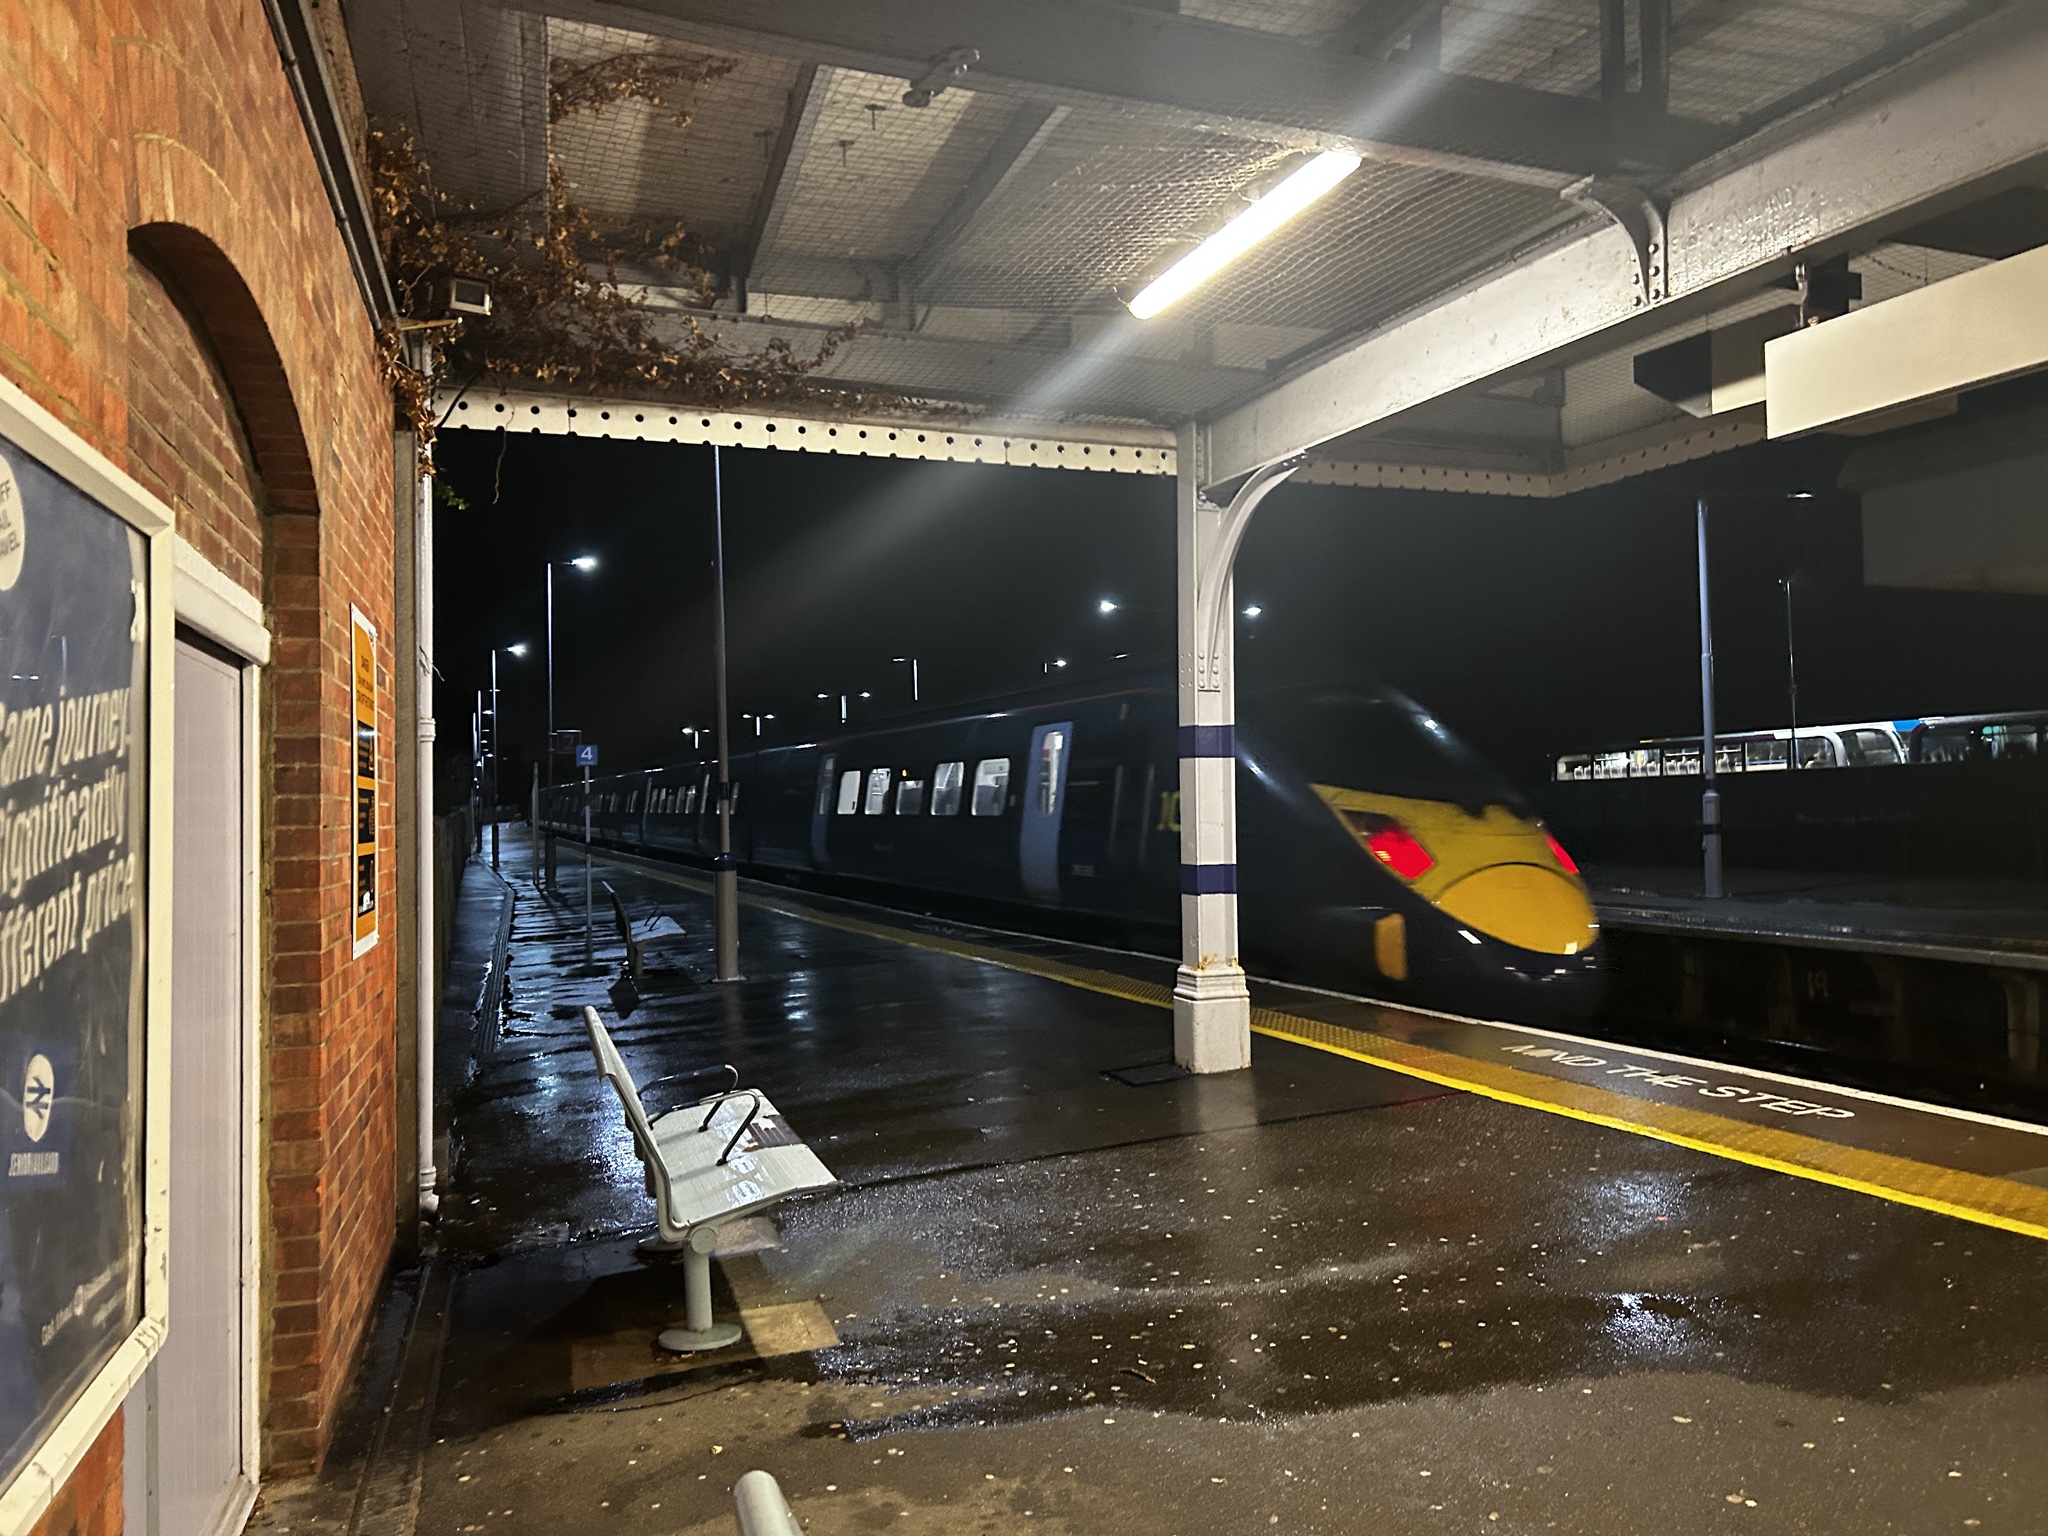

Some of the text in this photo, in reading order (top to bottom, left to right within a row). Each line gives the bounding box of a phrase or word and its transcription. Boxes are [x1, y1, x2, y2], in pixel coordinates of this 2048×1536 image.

[581, 747, 593, 760] 4
[0, 765, 126, 898] ignificantly
[0, 870, 81, 1001] fferent
[1606, 1064, 1708, 1088] THE
[1699, 1086, 1855, 1119] STEP
